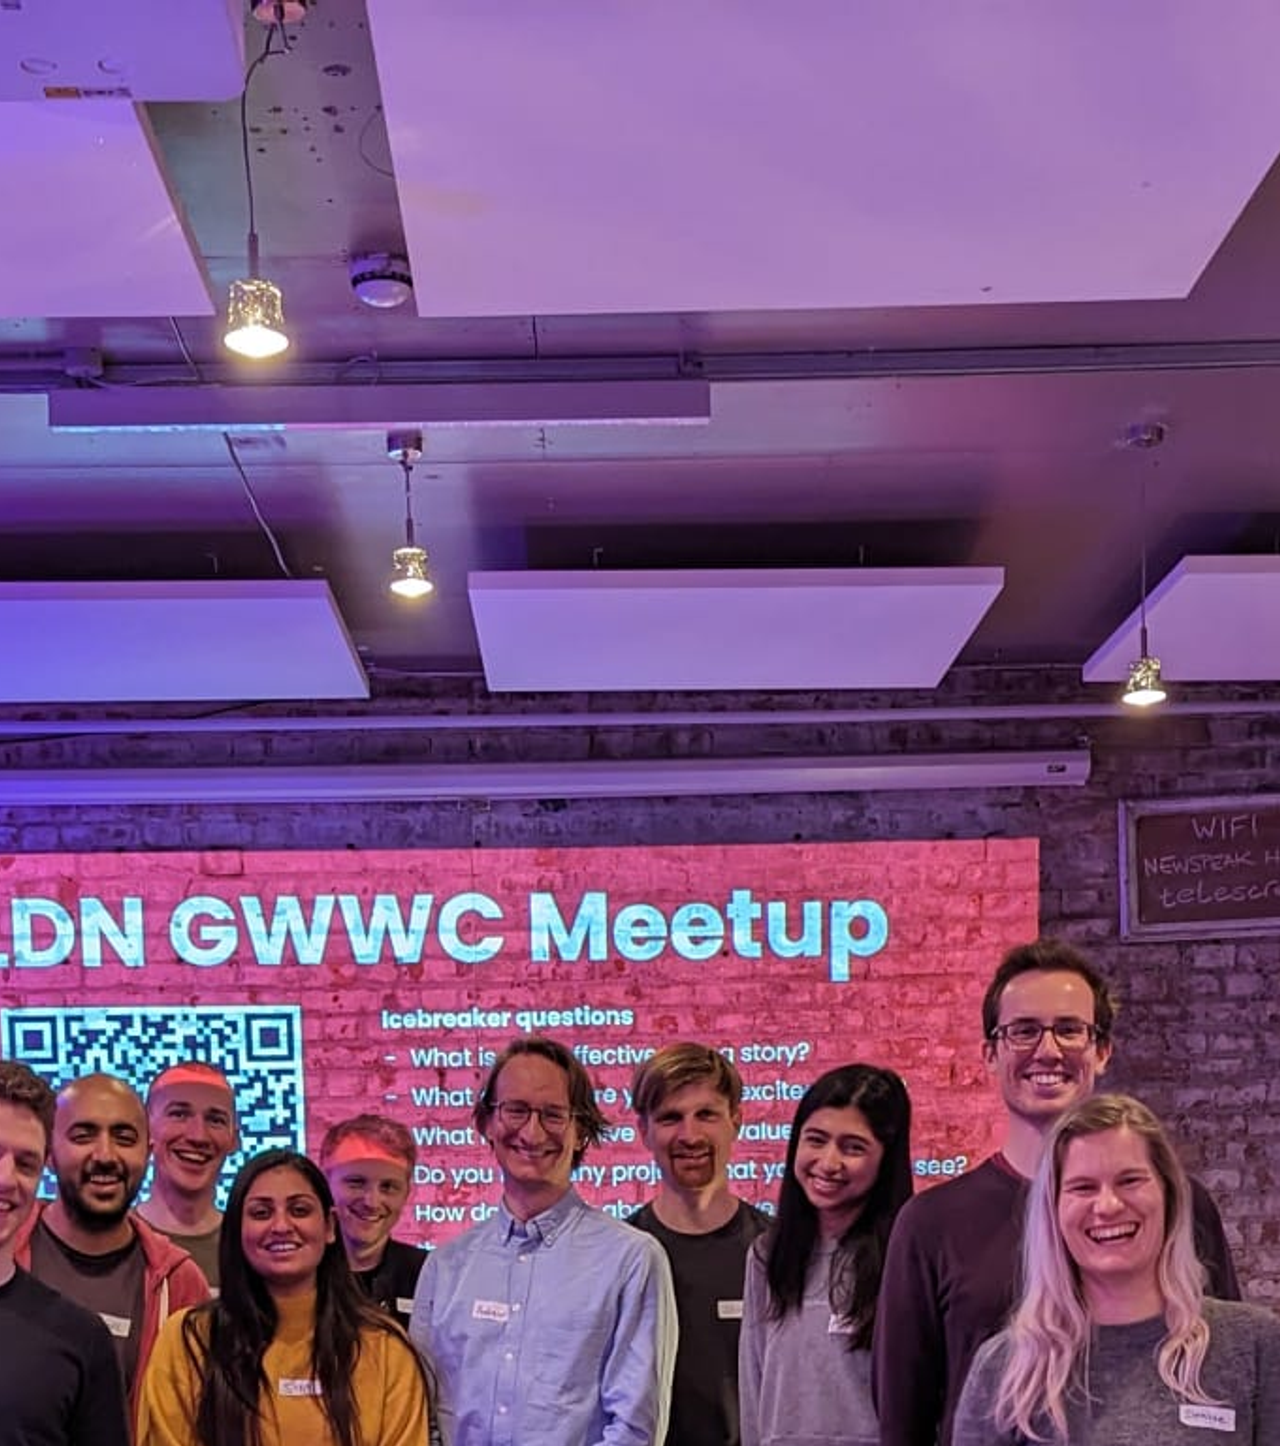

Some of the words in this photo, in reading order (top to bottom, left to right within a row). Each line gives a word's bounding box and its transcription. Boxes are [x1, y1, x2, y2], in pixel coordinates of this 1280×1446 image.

[1191, 813, 1258, 840] WIFI
[1144, 850, 1256, 877] NEWSPEAK
[168, 891, 505, 966] GWWC
[528, 888, 889, 983] Meetup
[381, 1007, 512, 1029] Icebreaker
[515, 1004, 634, 1033] questions
[410, 1046, 472, 1068] What
[479, 1046, 497, 1066] is
[573, 1044, 657, 1066] ffective
[741, 1041, 810, 1069] story?
[411, 1086, 473, 1107] What
[593, 1087, 617, 1104] re
[411, 1125, 474, 1146] What
[414, 1165, 446, 1185] Do
[450, 1167, 493, 1190] you
[763, 1162, 786, 1185] yo
[914, 1156, 967, 1176] see?
[415, 1204, 466, 1222] How
